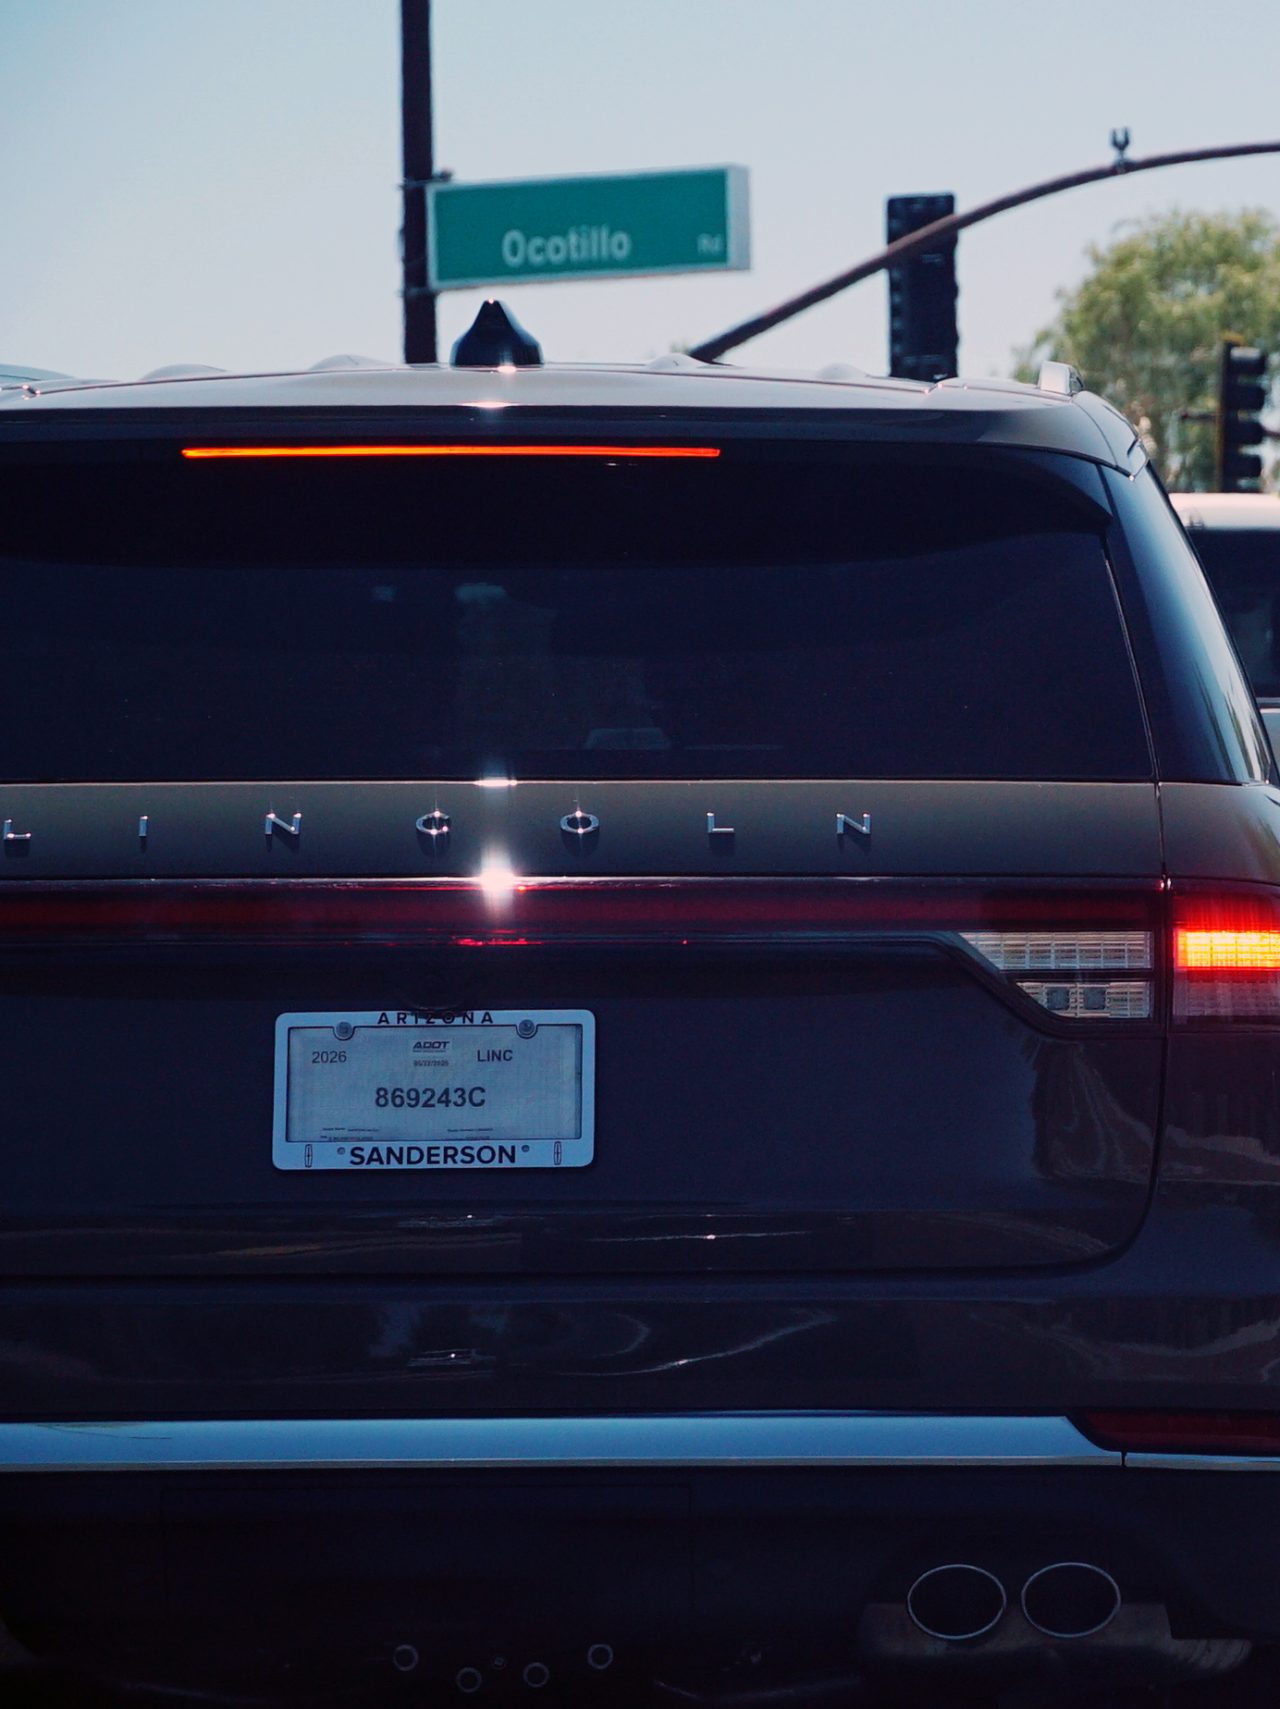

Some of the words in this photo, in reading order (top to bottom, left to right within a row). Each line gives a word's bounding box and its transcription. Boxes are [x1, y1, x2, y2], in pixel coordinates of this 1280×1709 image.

[502, 225, 631, 267] Ocotillo
[3, 808, 871, 840] LINCOLN
[377, 1011, 494, 1025] ARIZONA
[412, 1040, 450, 1049] ADOT
[311, 1051, 347, 1064] 2026
[477, 1049, 513, 1063] LINC
[374, 1086, 486, 1109] 869243C
[350, 1144, 516, 1166] SANDERSON
